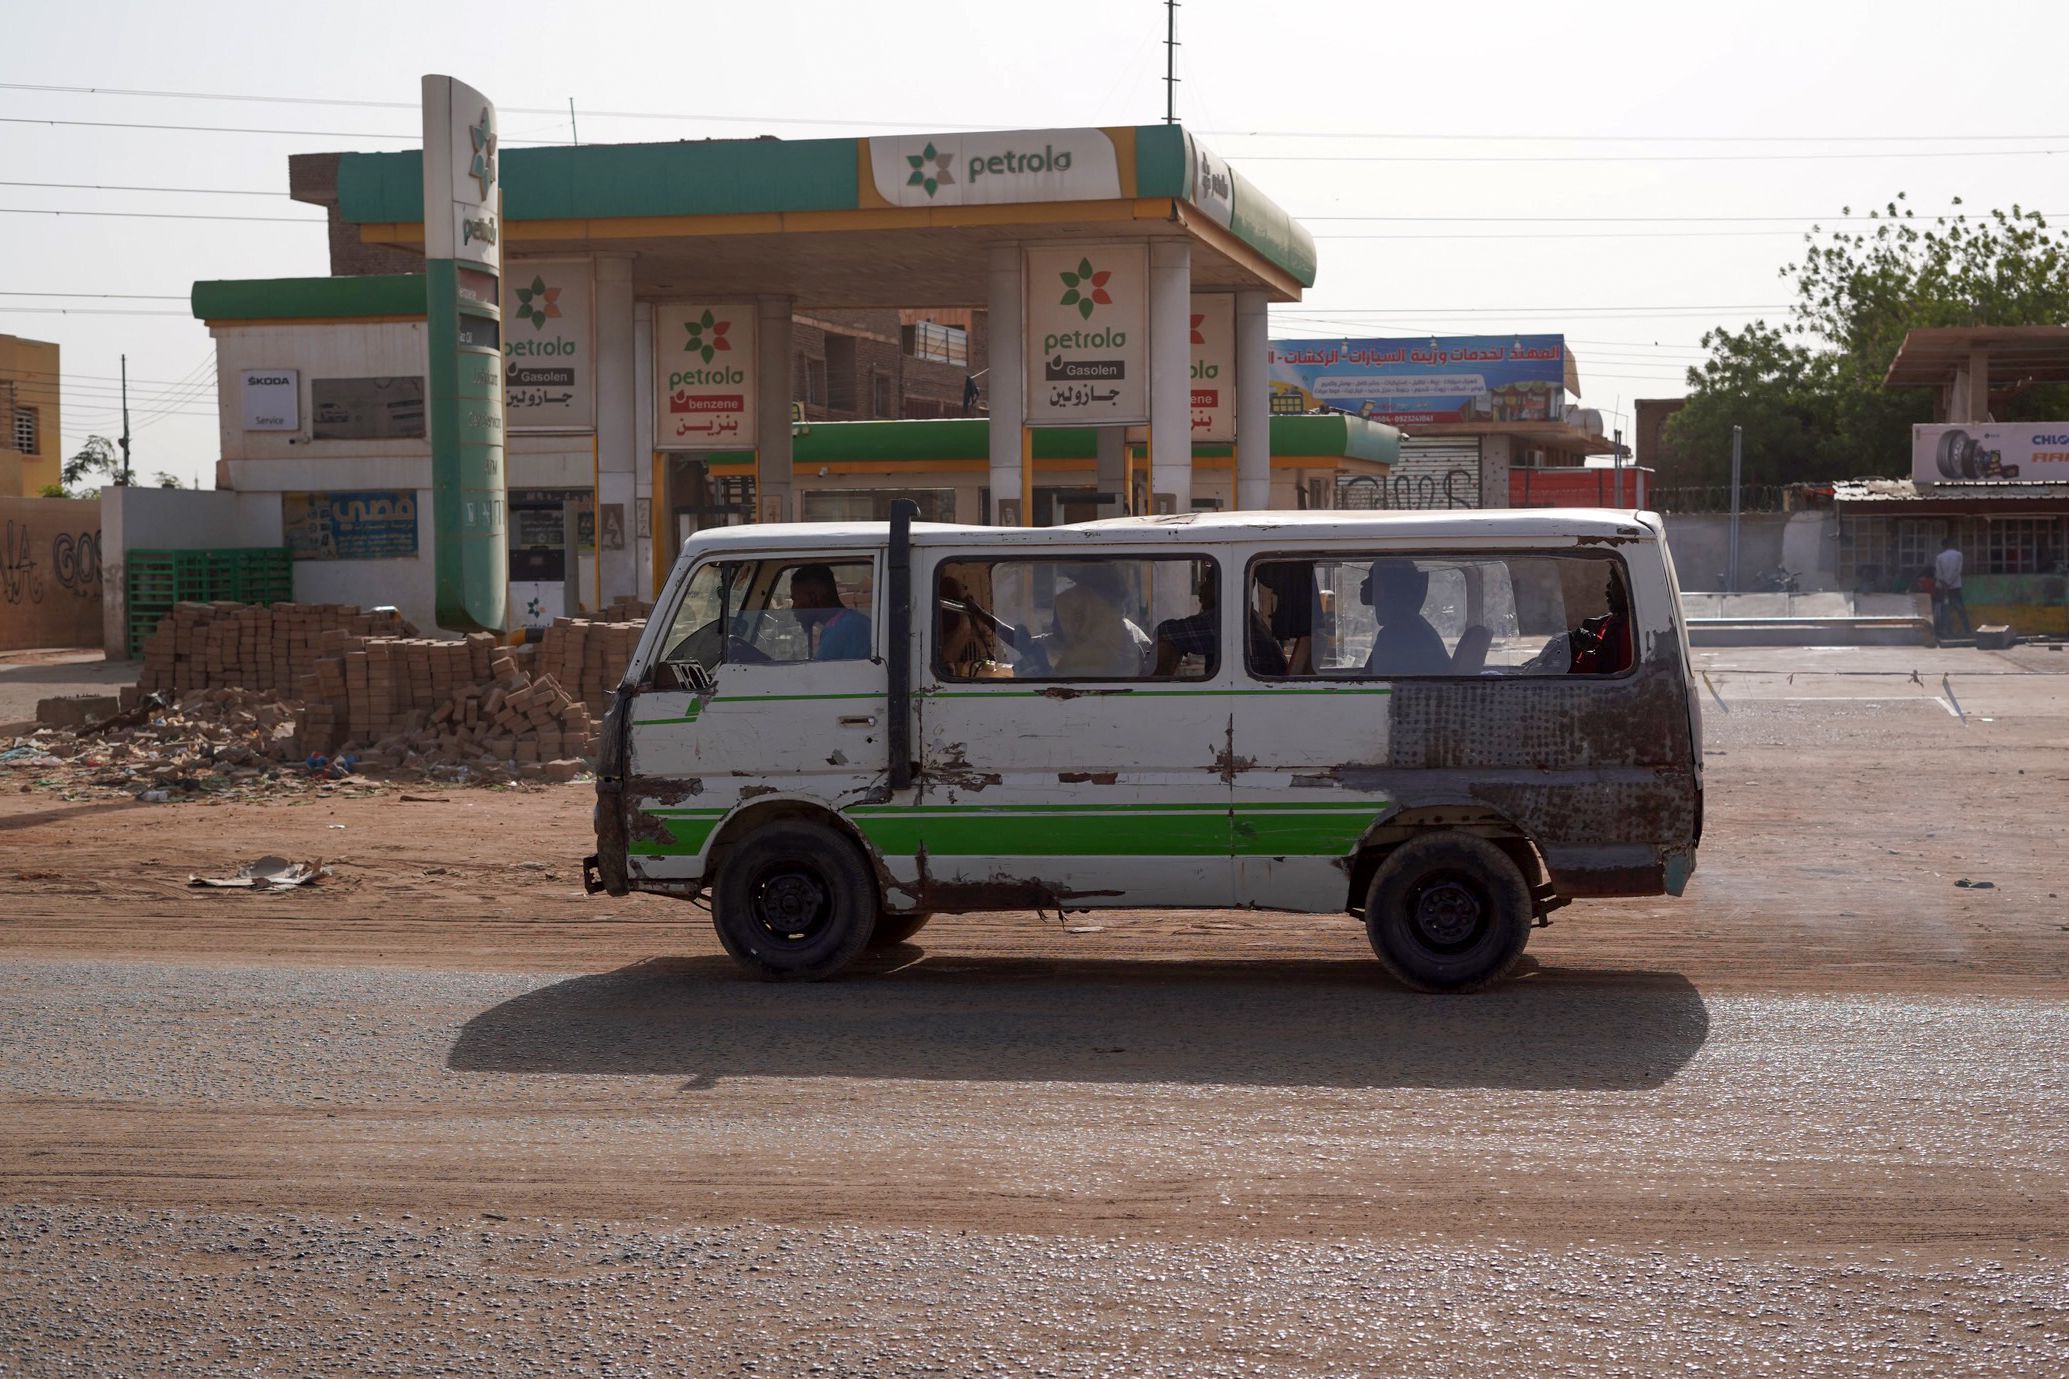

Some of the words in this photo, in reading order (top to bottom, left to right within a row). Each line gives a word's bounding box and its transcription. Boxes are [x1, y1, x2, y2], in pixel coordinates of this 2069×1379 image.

[968, 144, 1073, 184] petrola
[1044, 326, 1126, 355] petrola
[521, 371, 568, 382] Gasolen
[669, 365, 744, 391] petrola
[1066, 364, 1117, 377] Gasolen
[688, 399, 738, 409] benzene
[1049, 383, 1120, 407] جازولين
[255, 416, 284, 425] Service
[676, 414, 739, 437] بنزين
